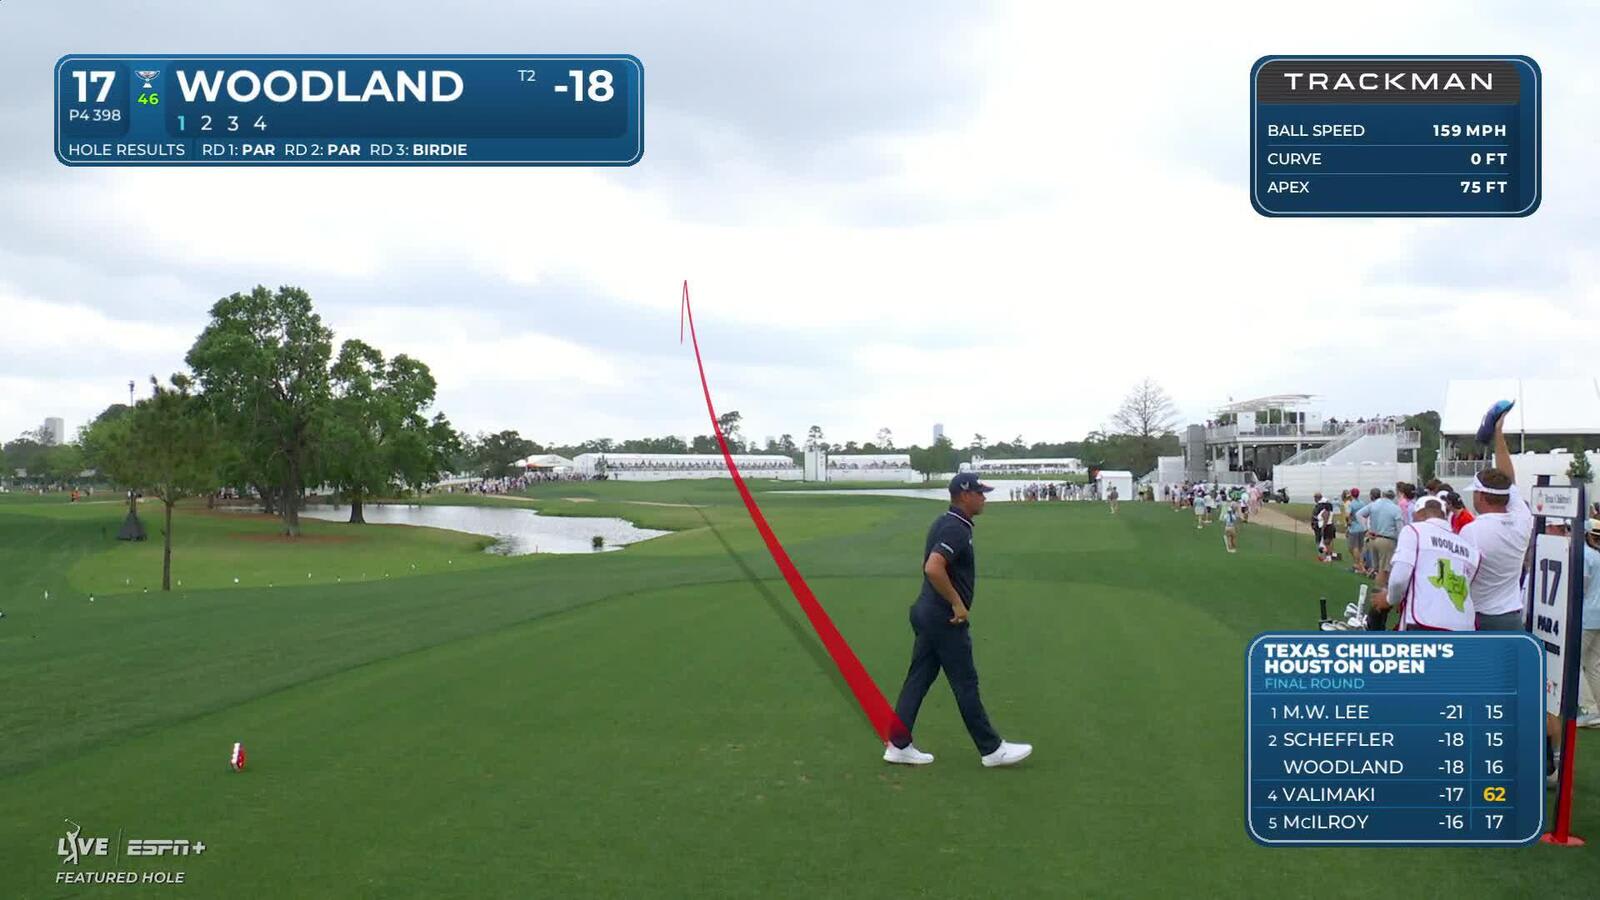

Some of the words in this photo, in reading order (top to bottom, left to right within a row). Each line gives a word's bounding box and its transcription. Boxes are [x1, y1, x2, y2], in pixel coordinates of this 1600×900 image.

[1430, 536, 1470, 558] WOODLAND
[1540, 558, 1562, 607] 17
[1553, 620, 1560, 636] 4
